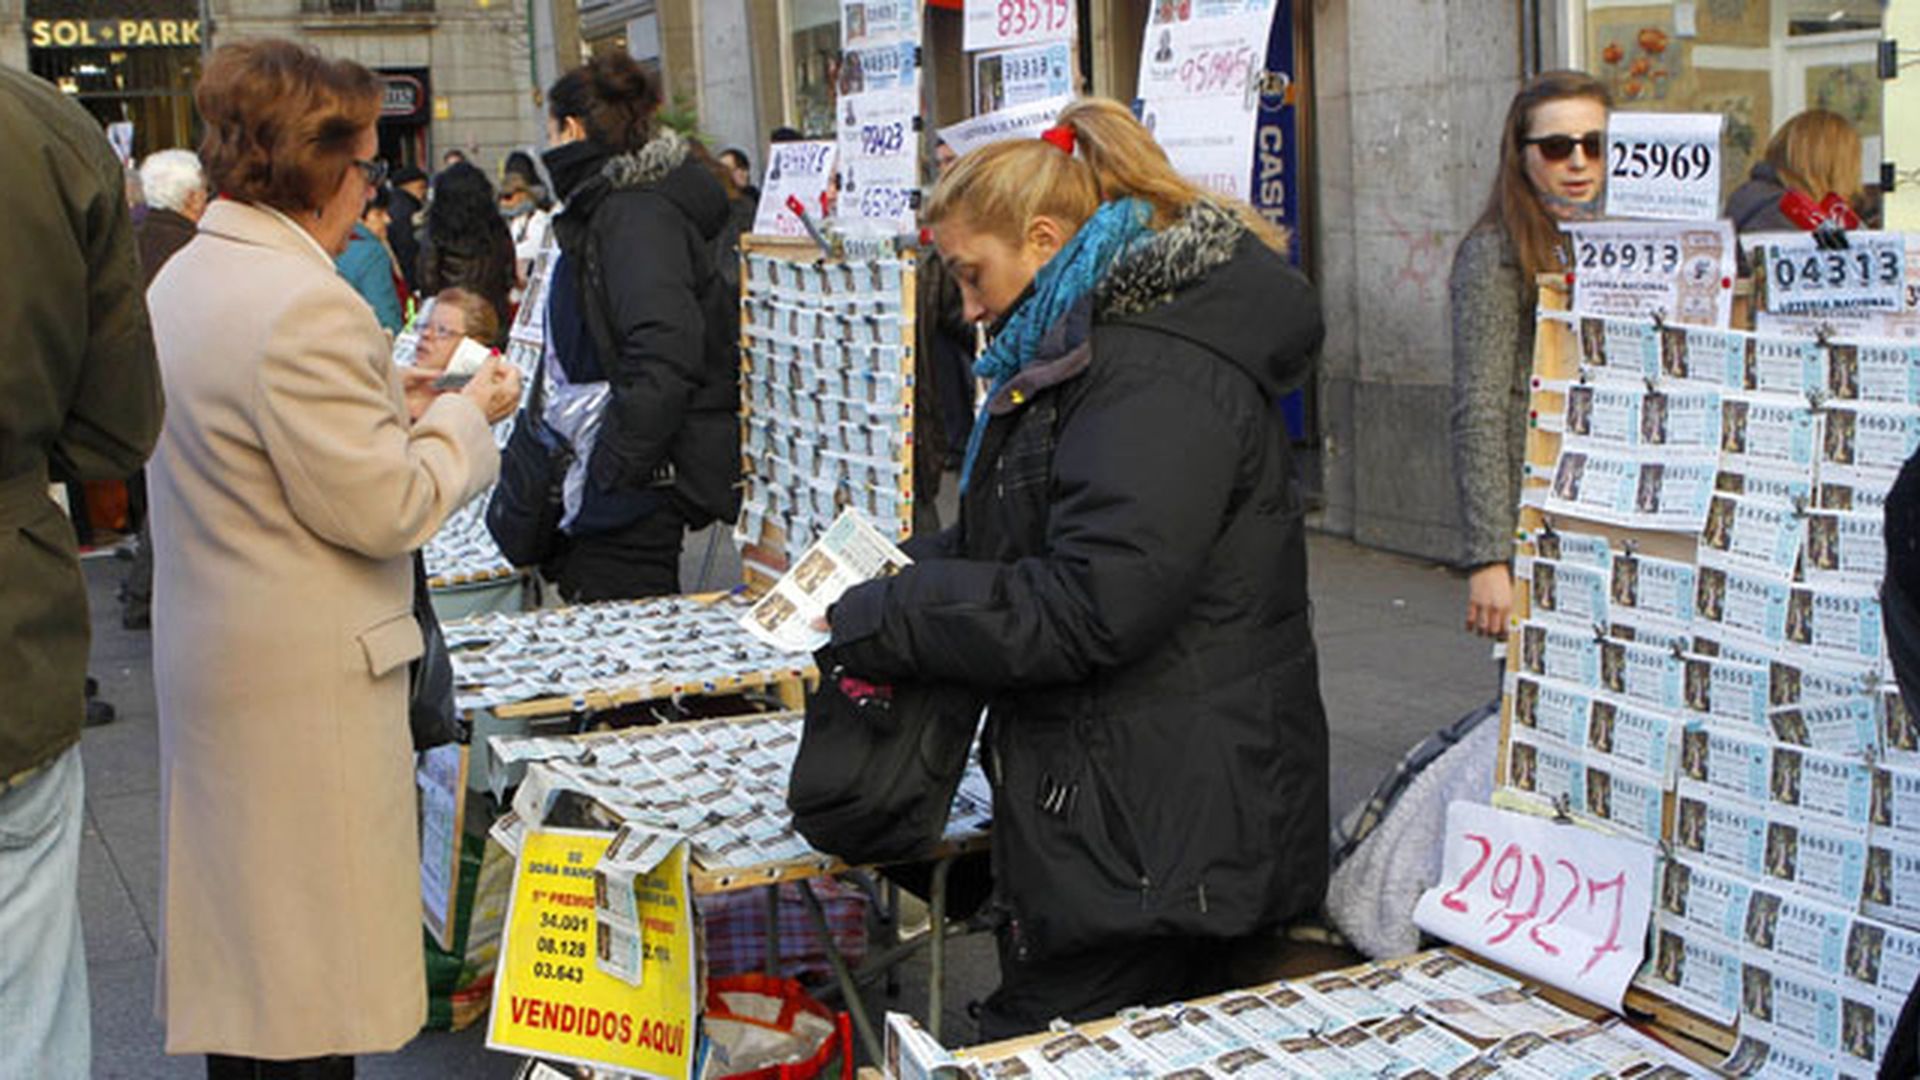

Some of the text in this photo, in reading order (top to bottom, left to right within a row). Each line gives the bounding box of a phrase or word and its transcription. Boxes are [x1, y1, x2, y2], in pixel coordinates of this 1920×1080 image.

[32, 19, 201, 47] SOL PARK
[1612, 142, 1711, 180] 25969
[1581, 243, 1678, 273] 26913
[1776, 251, 1899, 288] 04313
[511, 995, 686, 1057] VENDIDOS AQUÍ
